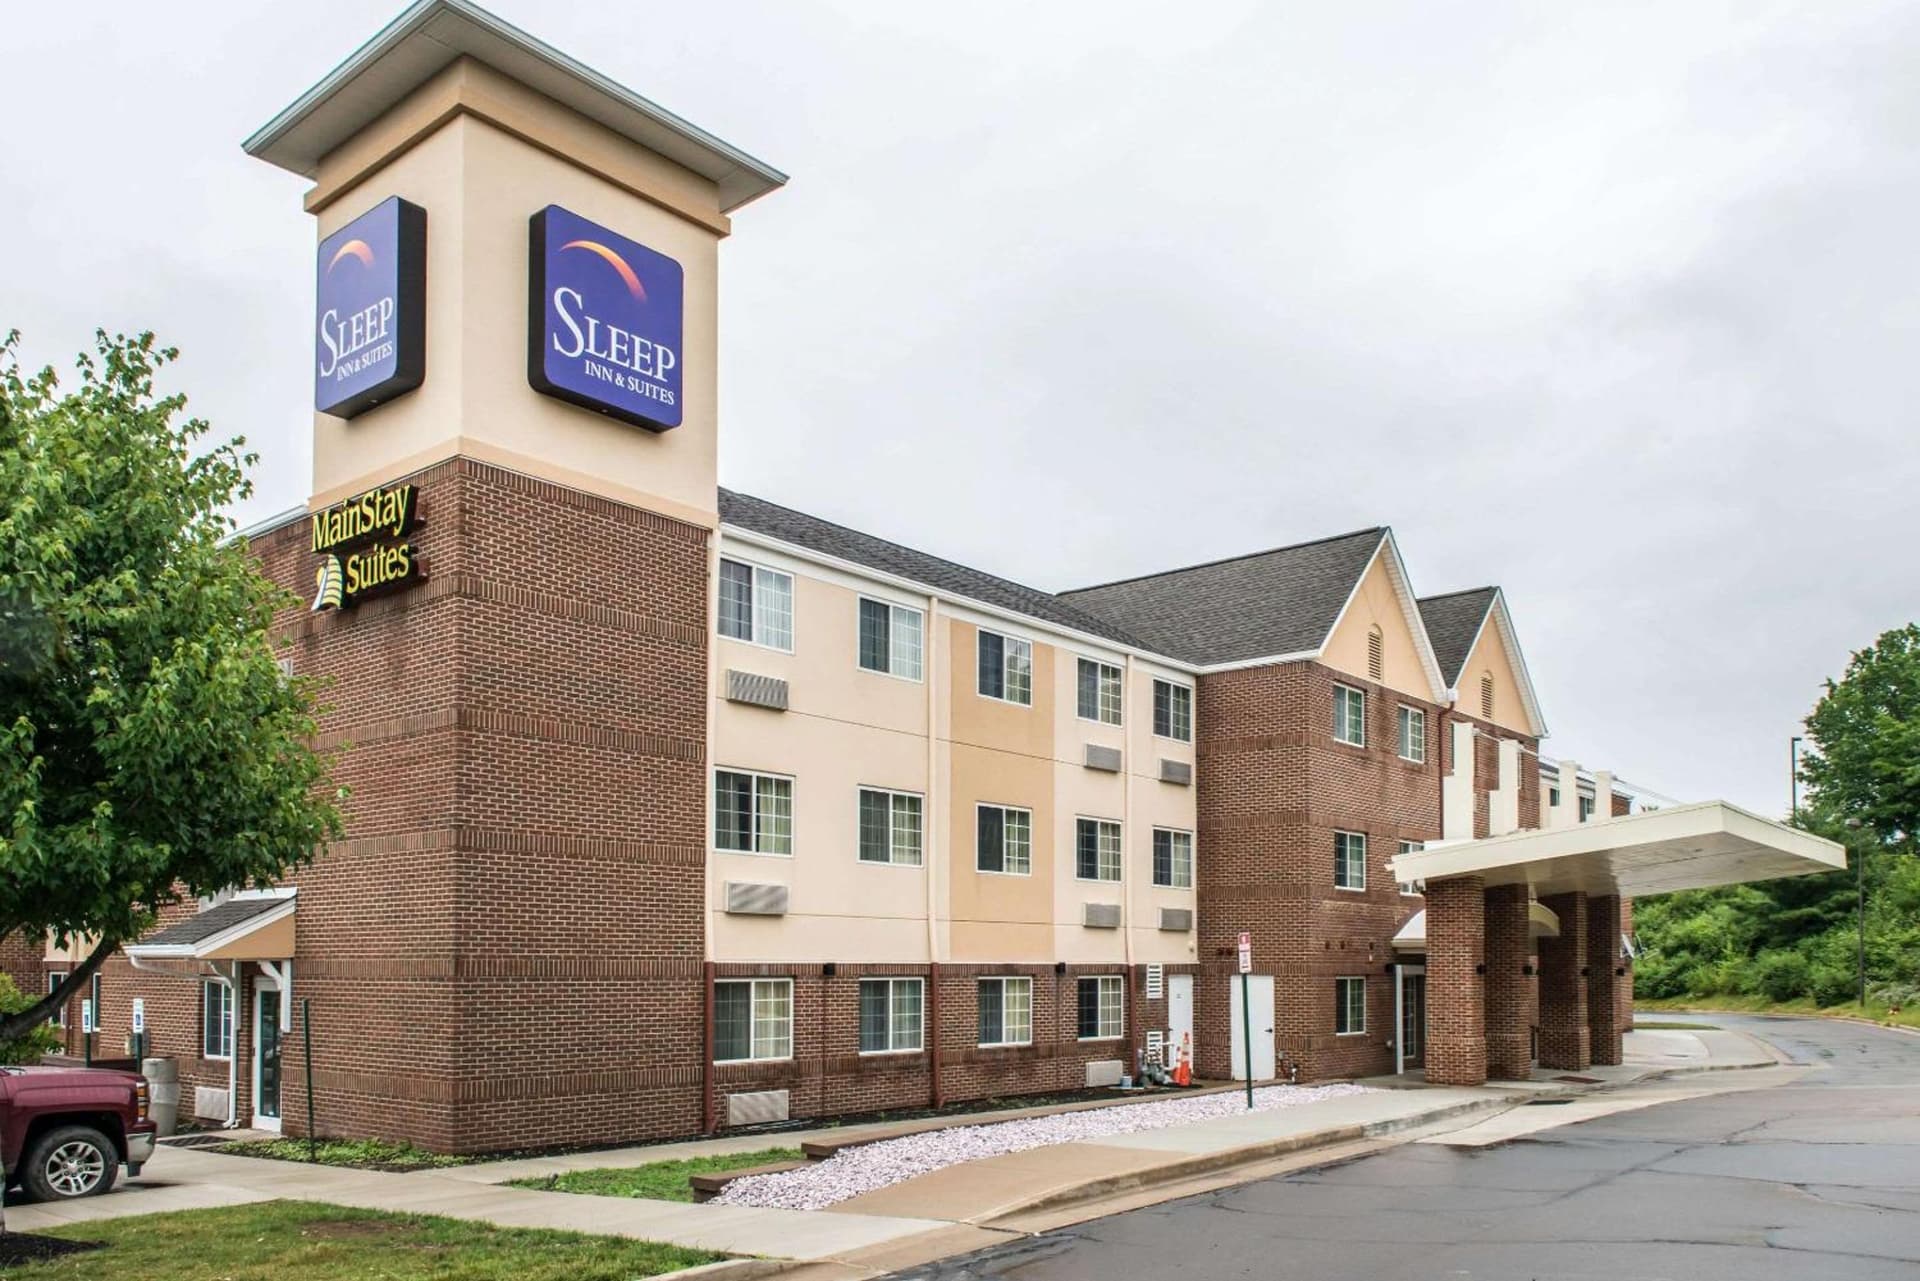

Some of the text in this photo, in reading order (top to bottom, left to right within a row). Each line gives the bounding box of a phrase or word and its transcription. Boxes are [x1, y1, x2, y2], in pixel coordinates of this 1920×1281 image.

[321, 296, 393, 377] SLEEP
[361, 340, 393, 369] SUITES
[553, 286, 676, 382] SLEEP
[584, 359, 675, 406] INN & SUITES
[311, 484, 411, 552] MainStay
[346, 543, 410, 594] Suites
